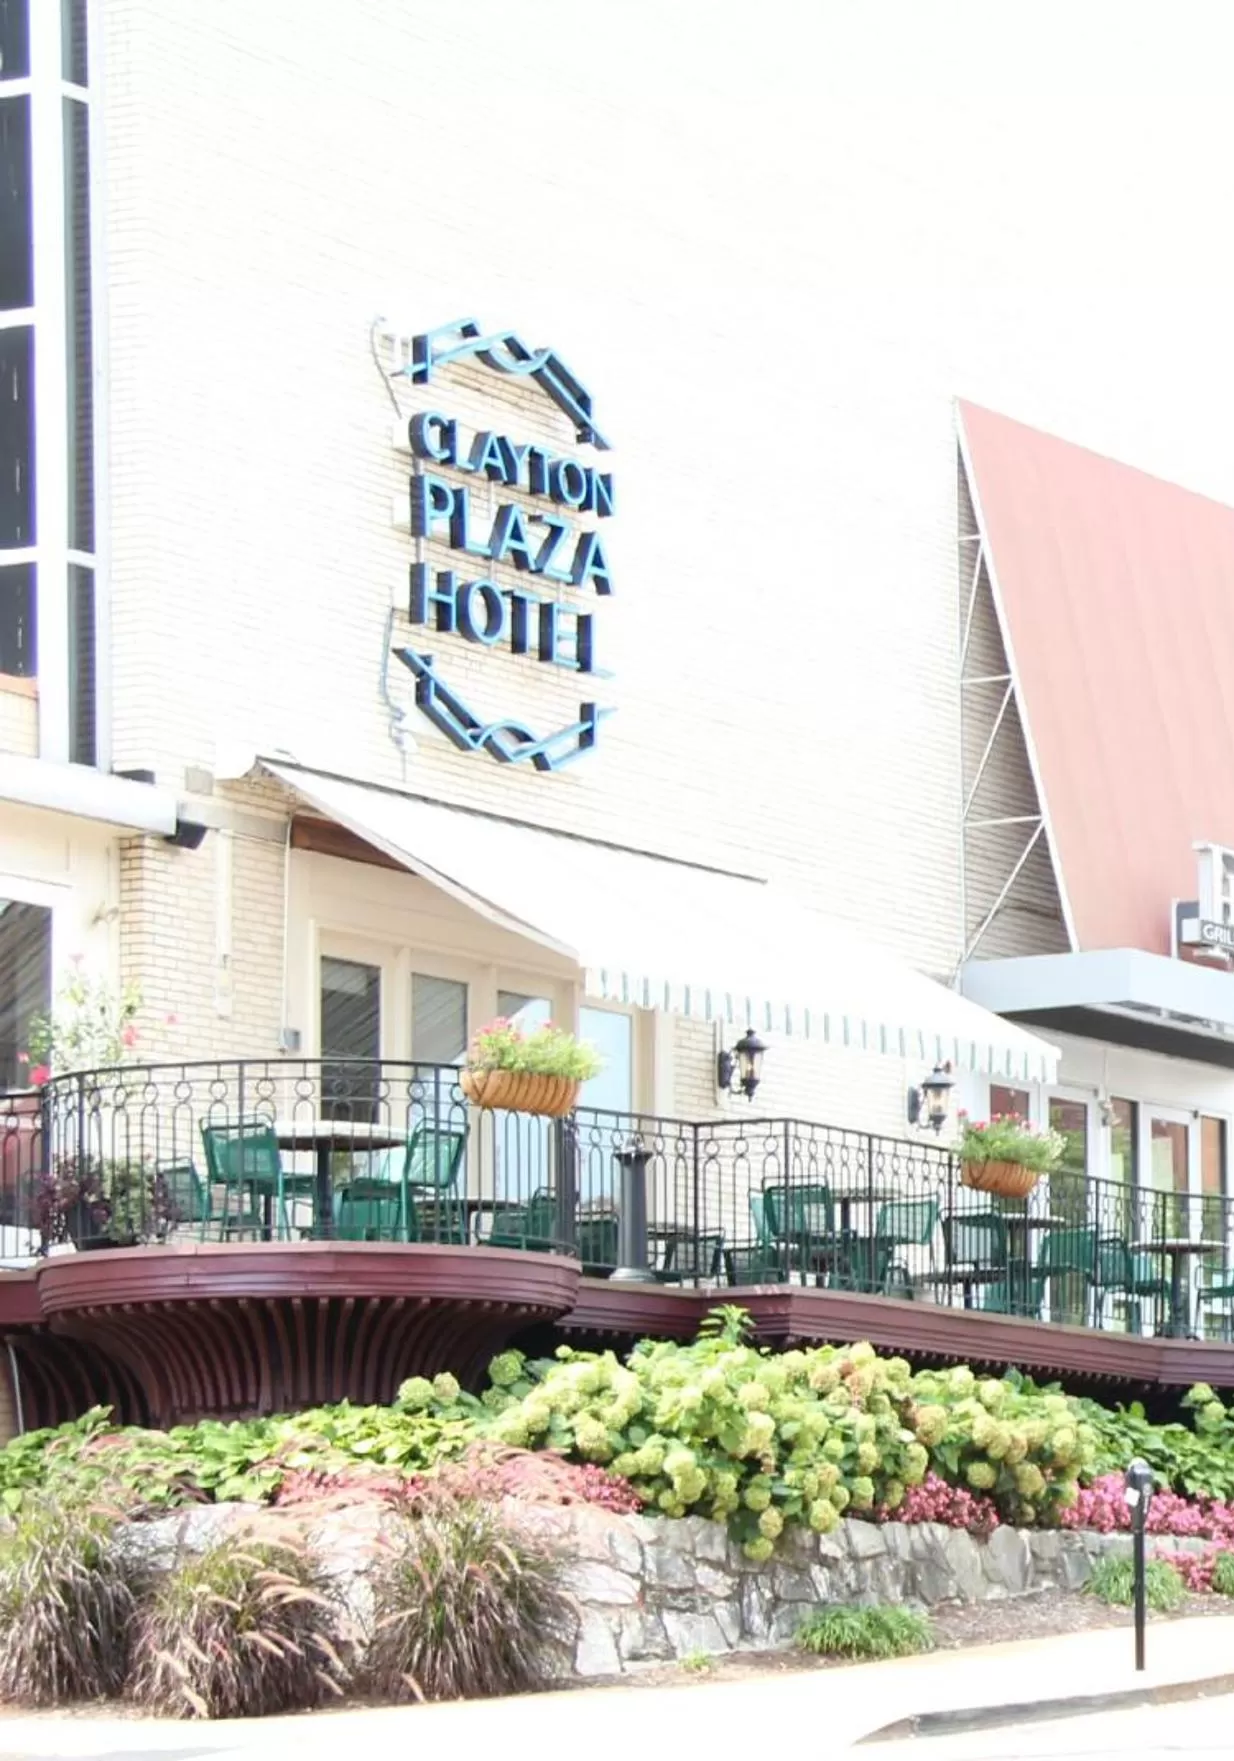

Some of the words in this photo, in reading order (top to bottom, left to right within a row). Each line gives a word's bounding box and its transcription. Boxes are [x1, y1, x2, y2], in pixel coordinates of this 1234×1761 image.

[409, 410, 615, 517] CLAYTON
[410, 474, 615, 596] PLAZA
[409, 562, 616, 680] HOTEL
